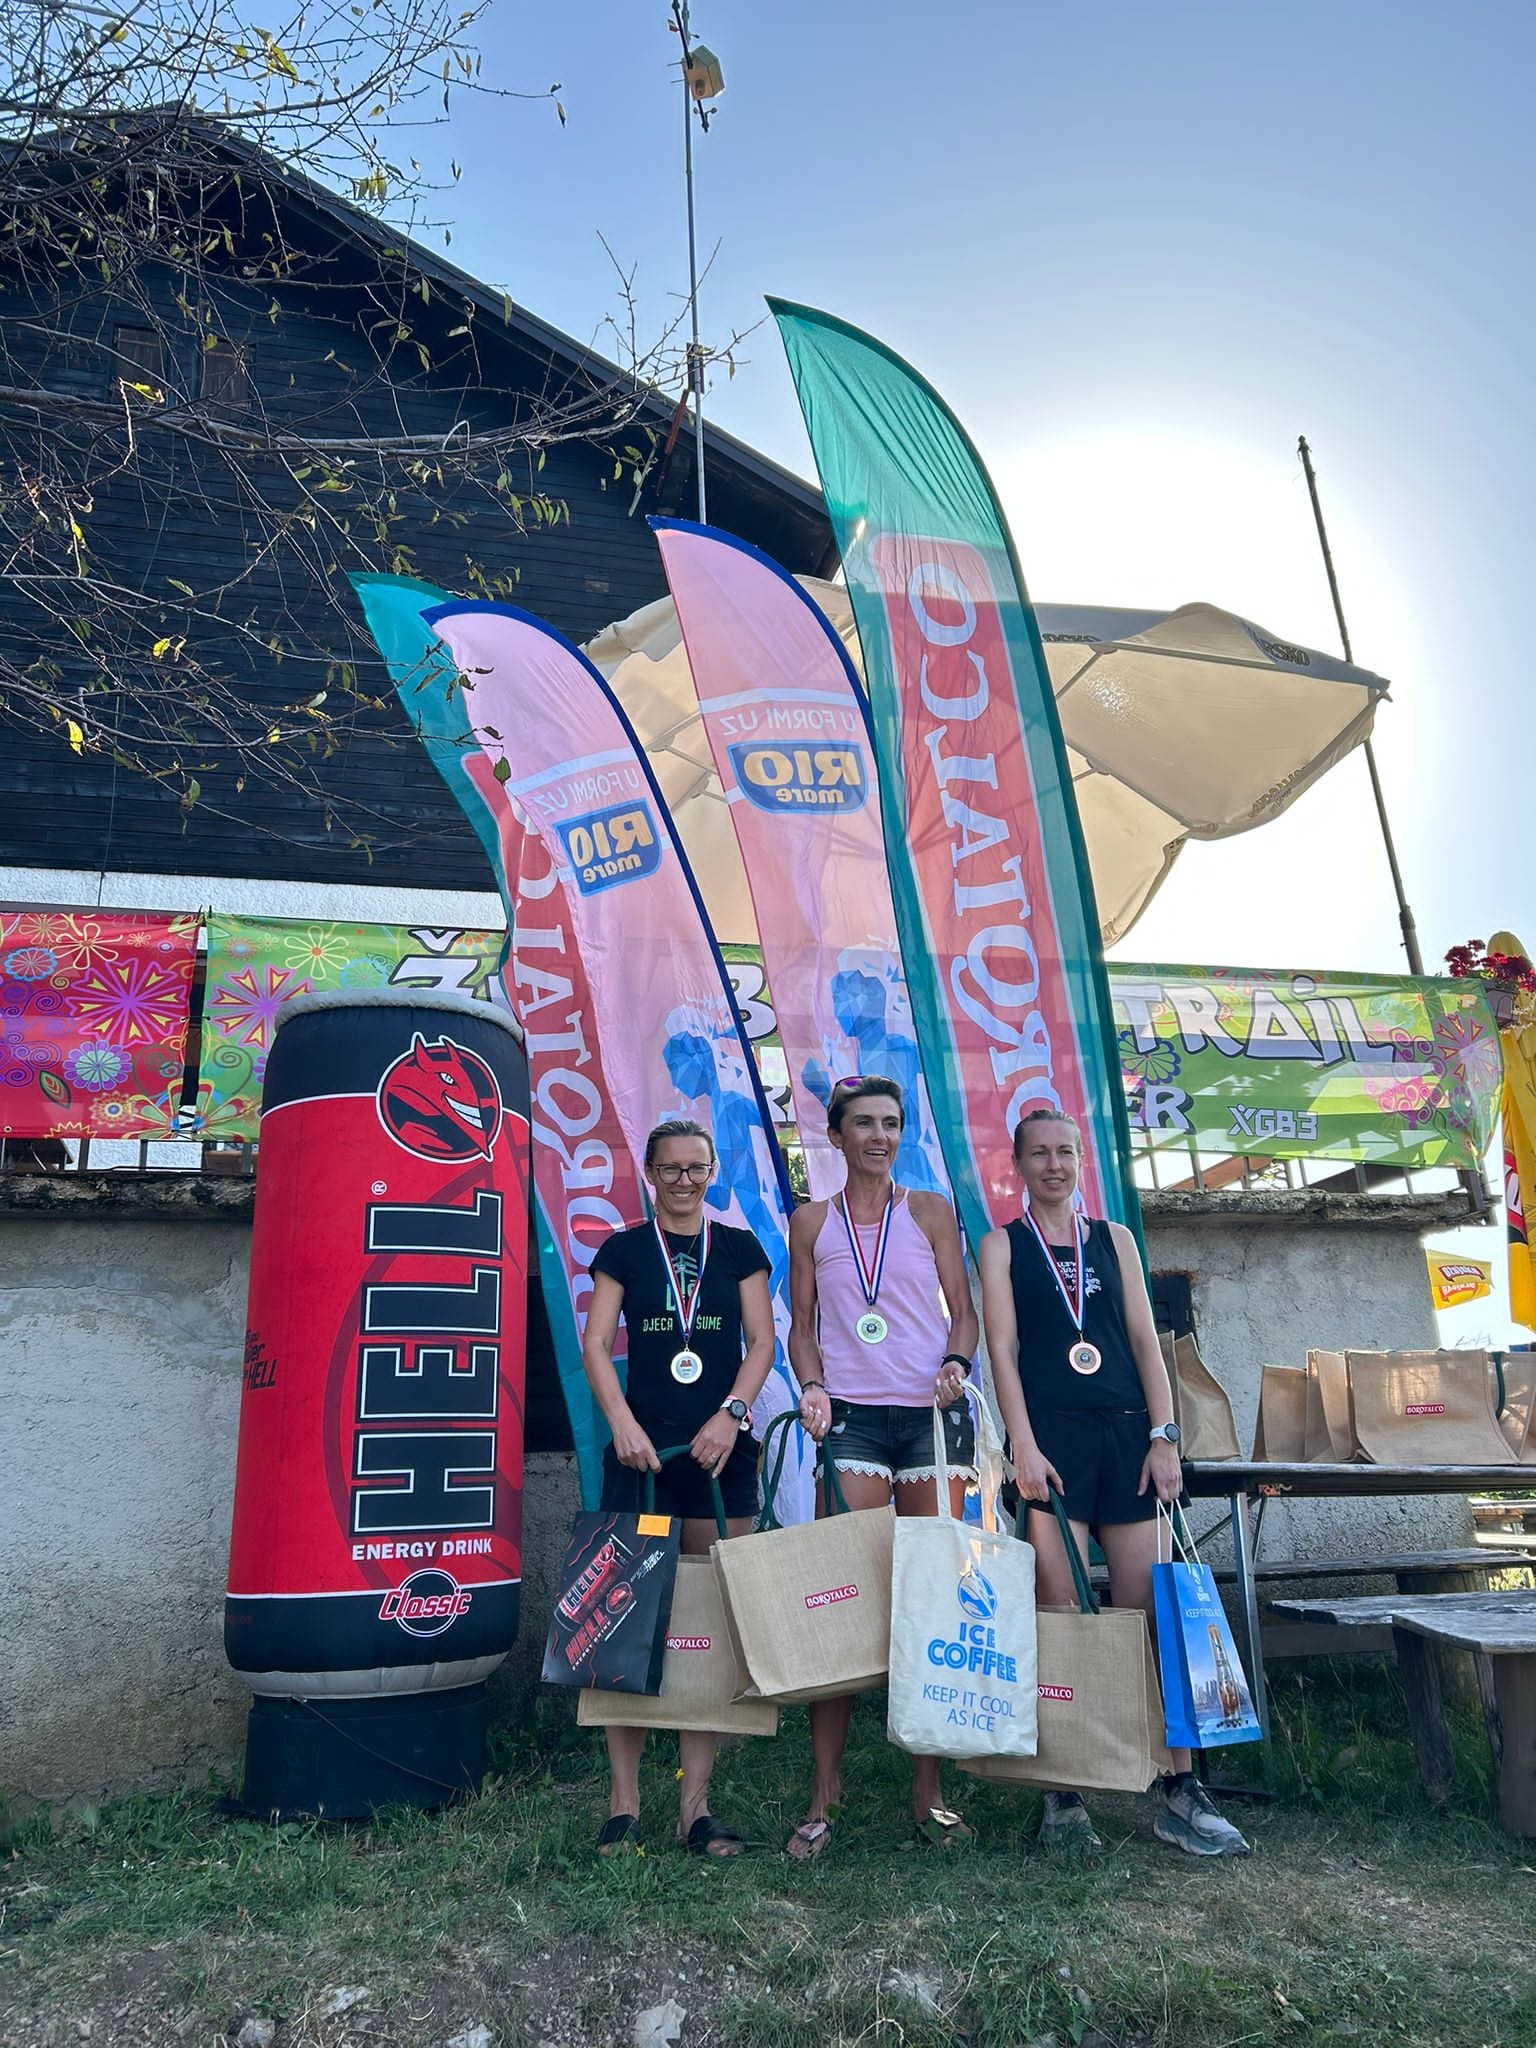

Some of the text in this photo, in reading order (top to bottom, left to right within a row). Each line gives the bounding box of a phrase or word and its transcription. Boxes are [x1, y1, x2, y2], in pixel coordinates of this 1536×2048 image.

[642, 1317, 673, 1332] DJECA
[352, 1189, 503, 1535] HELL
[352, 1537, 492, 1561] ENERGY DRINK
[378, 1588, 472, 1620] Classic
[806, 1586, 857, 1607] BOROTALCO
[666, 1639, 710, 1650] ROTALCO
[959, 1622, 996, 1648] ICE
[927, 1638, 1017, 1683] COFFEE
[922, 1683, 1017, 1718] KEEP IT COOL
[946, 1708, 996, 1733] AS ICE
